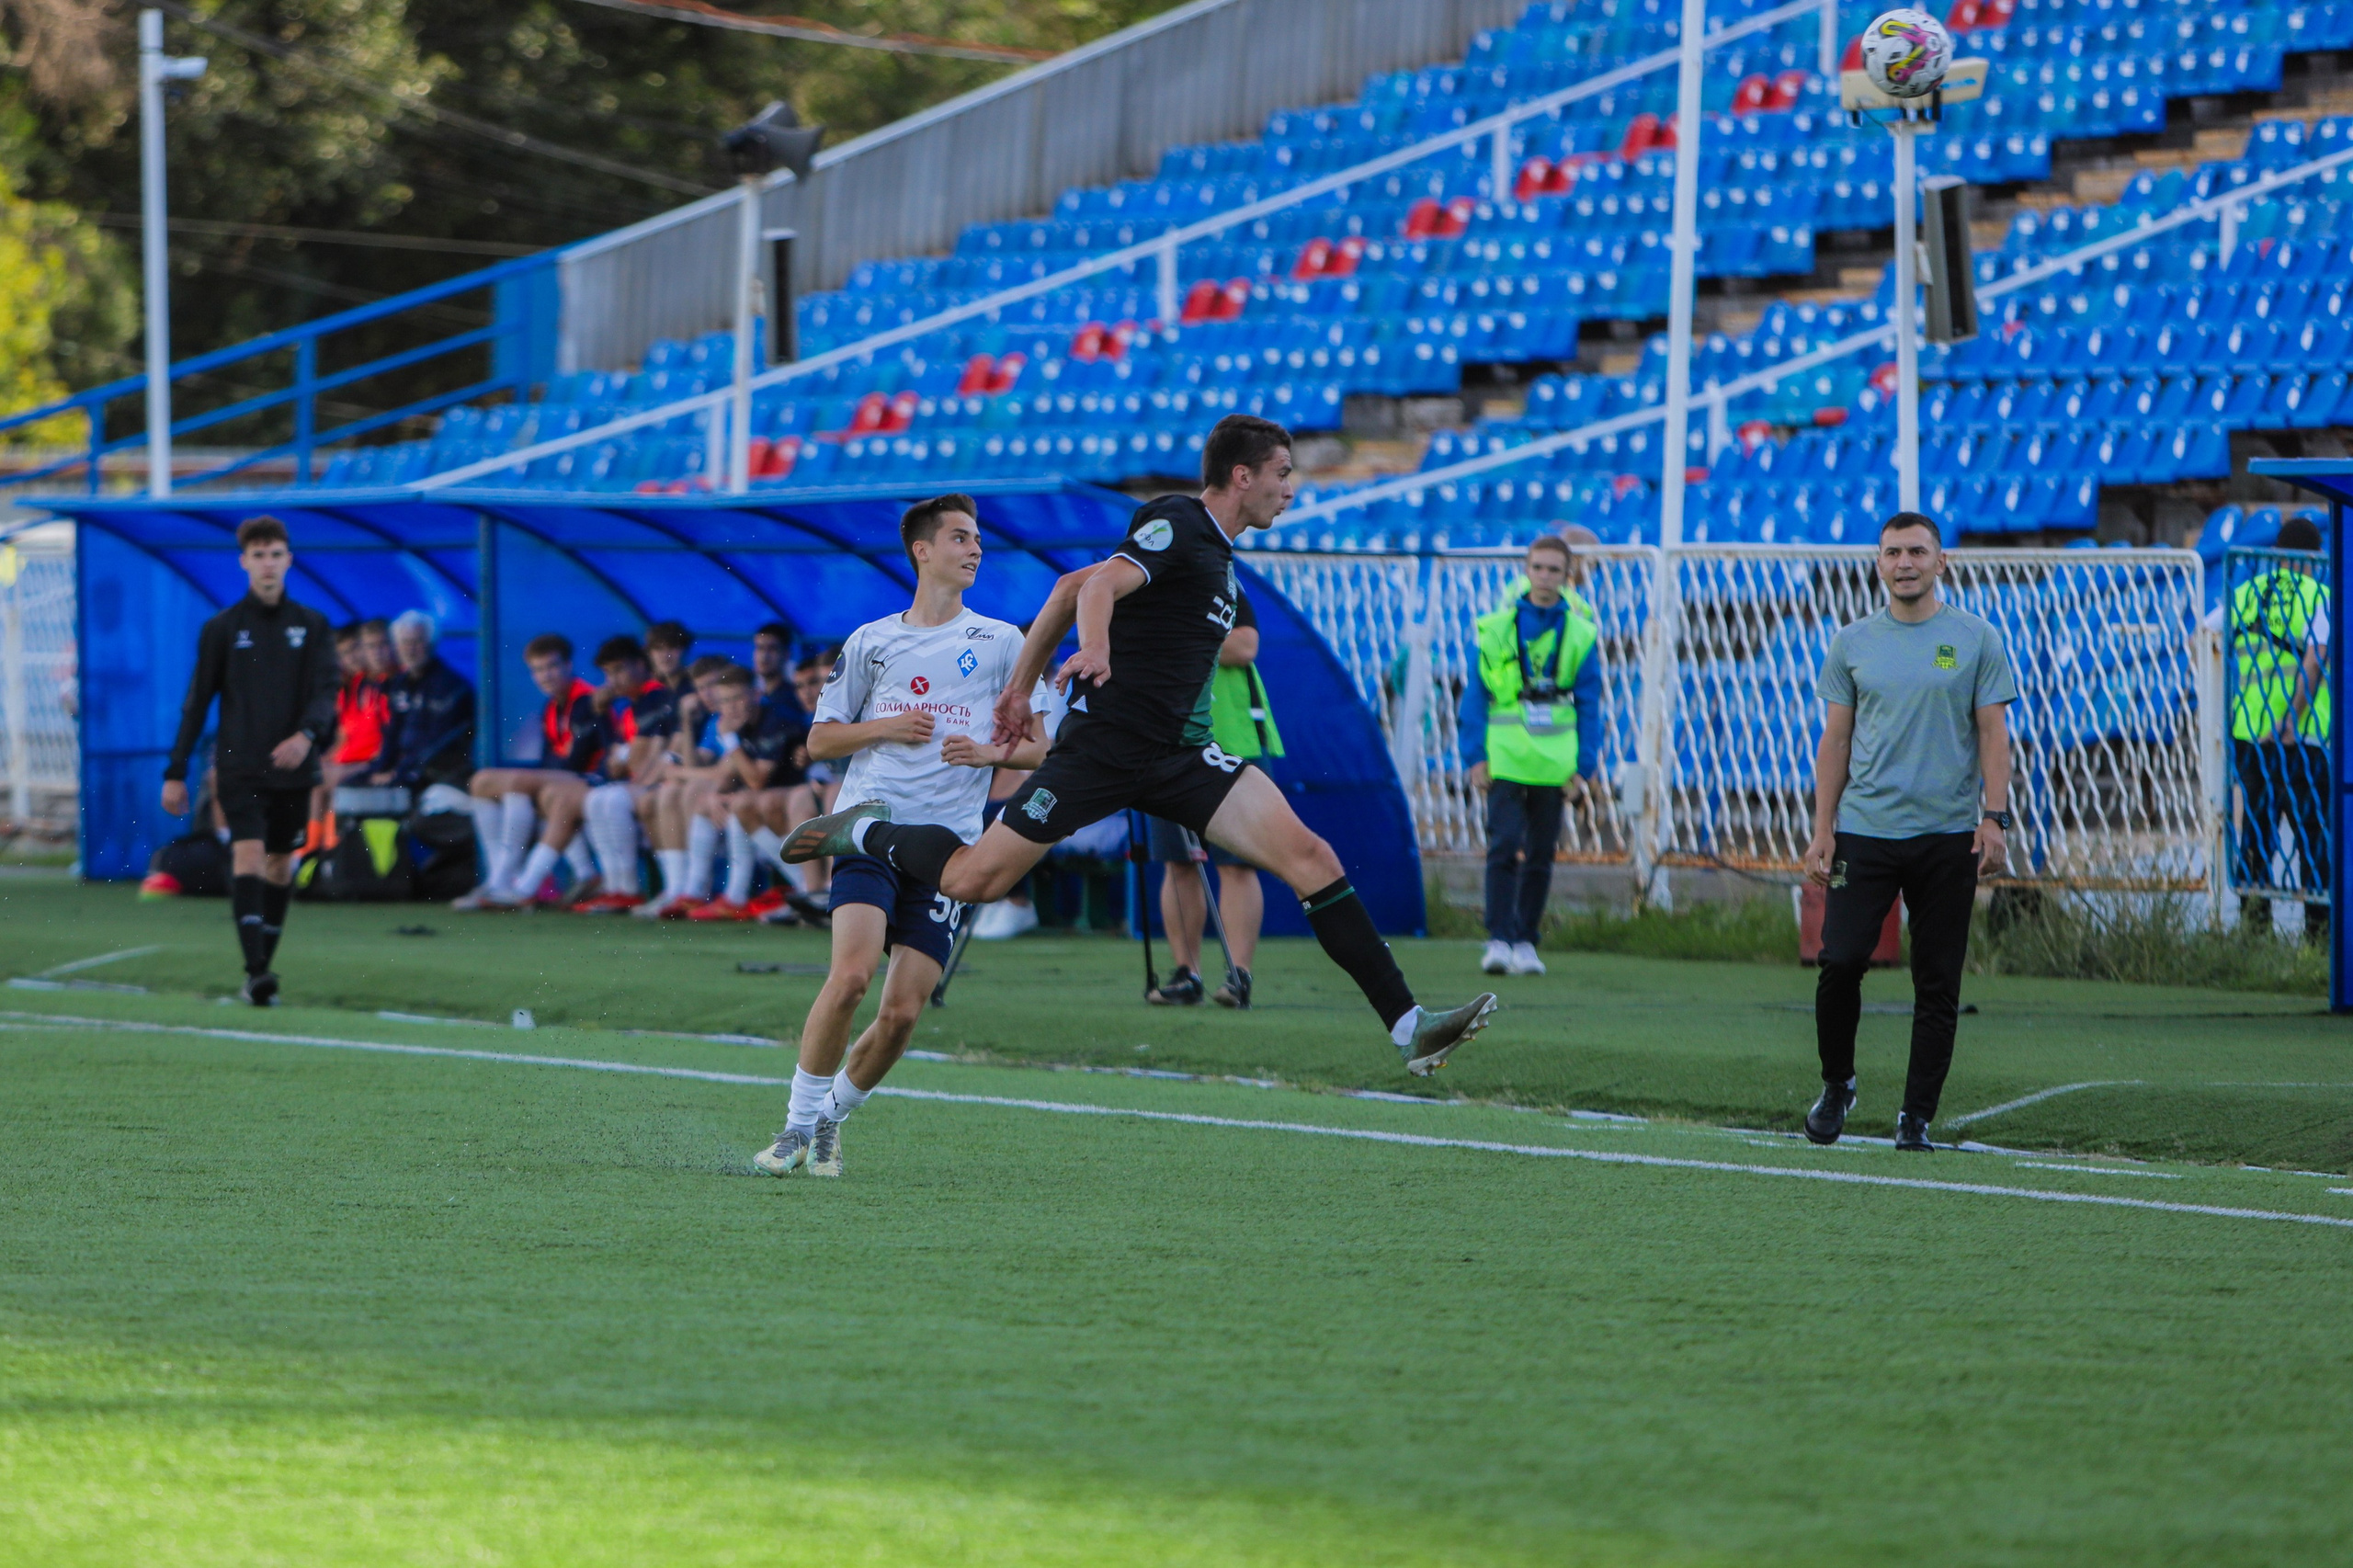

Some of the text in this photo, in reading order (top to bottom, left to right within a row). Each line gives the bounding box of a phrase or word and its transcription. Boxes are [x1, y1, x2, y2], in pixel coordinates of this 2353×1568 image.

[875, 701, 972, 718] СОЛИДАРНОСТЬ
[946, 717, 971, 727] БАНК
[928, 891, 967, 931] 58
